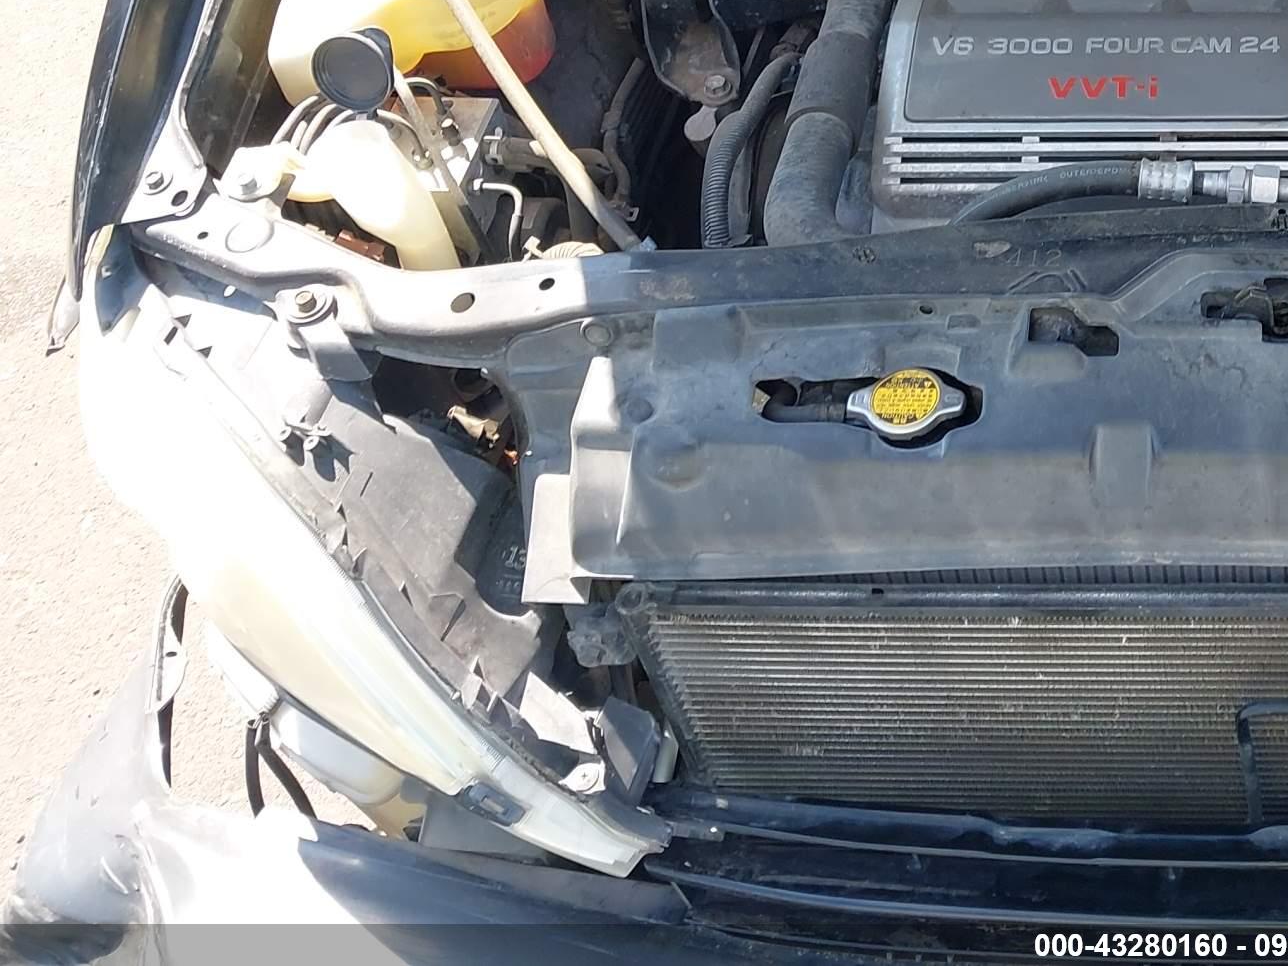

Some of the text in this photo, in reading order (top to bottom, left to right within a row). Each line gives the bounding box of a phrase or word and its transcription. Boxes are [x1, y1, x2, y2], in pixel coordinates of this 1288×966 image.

[931, 36, 1281, 55] V6 3000 FOUR CAM 24
[1047, 76, 1159, 99] VVT-i
